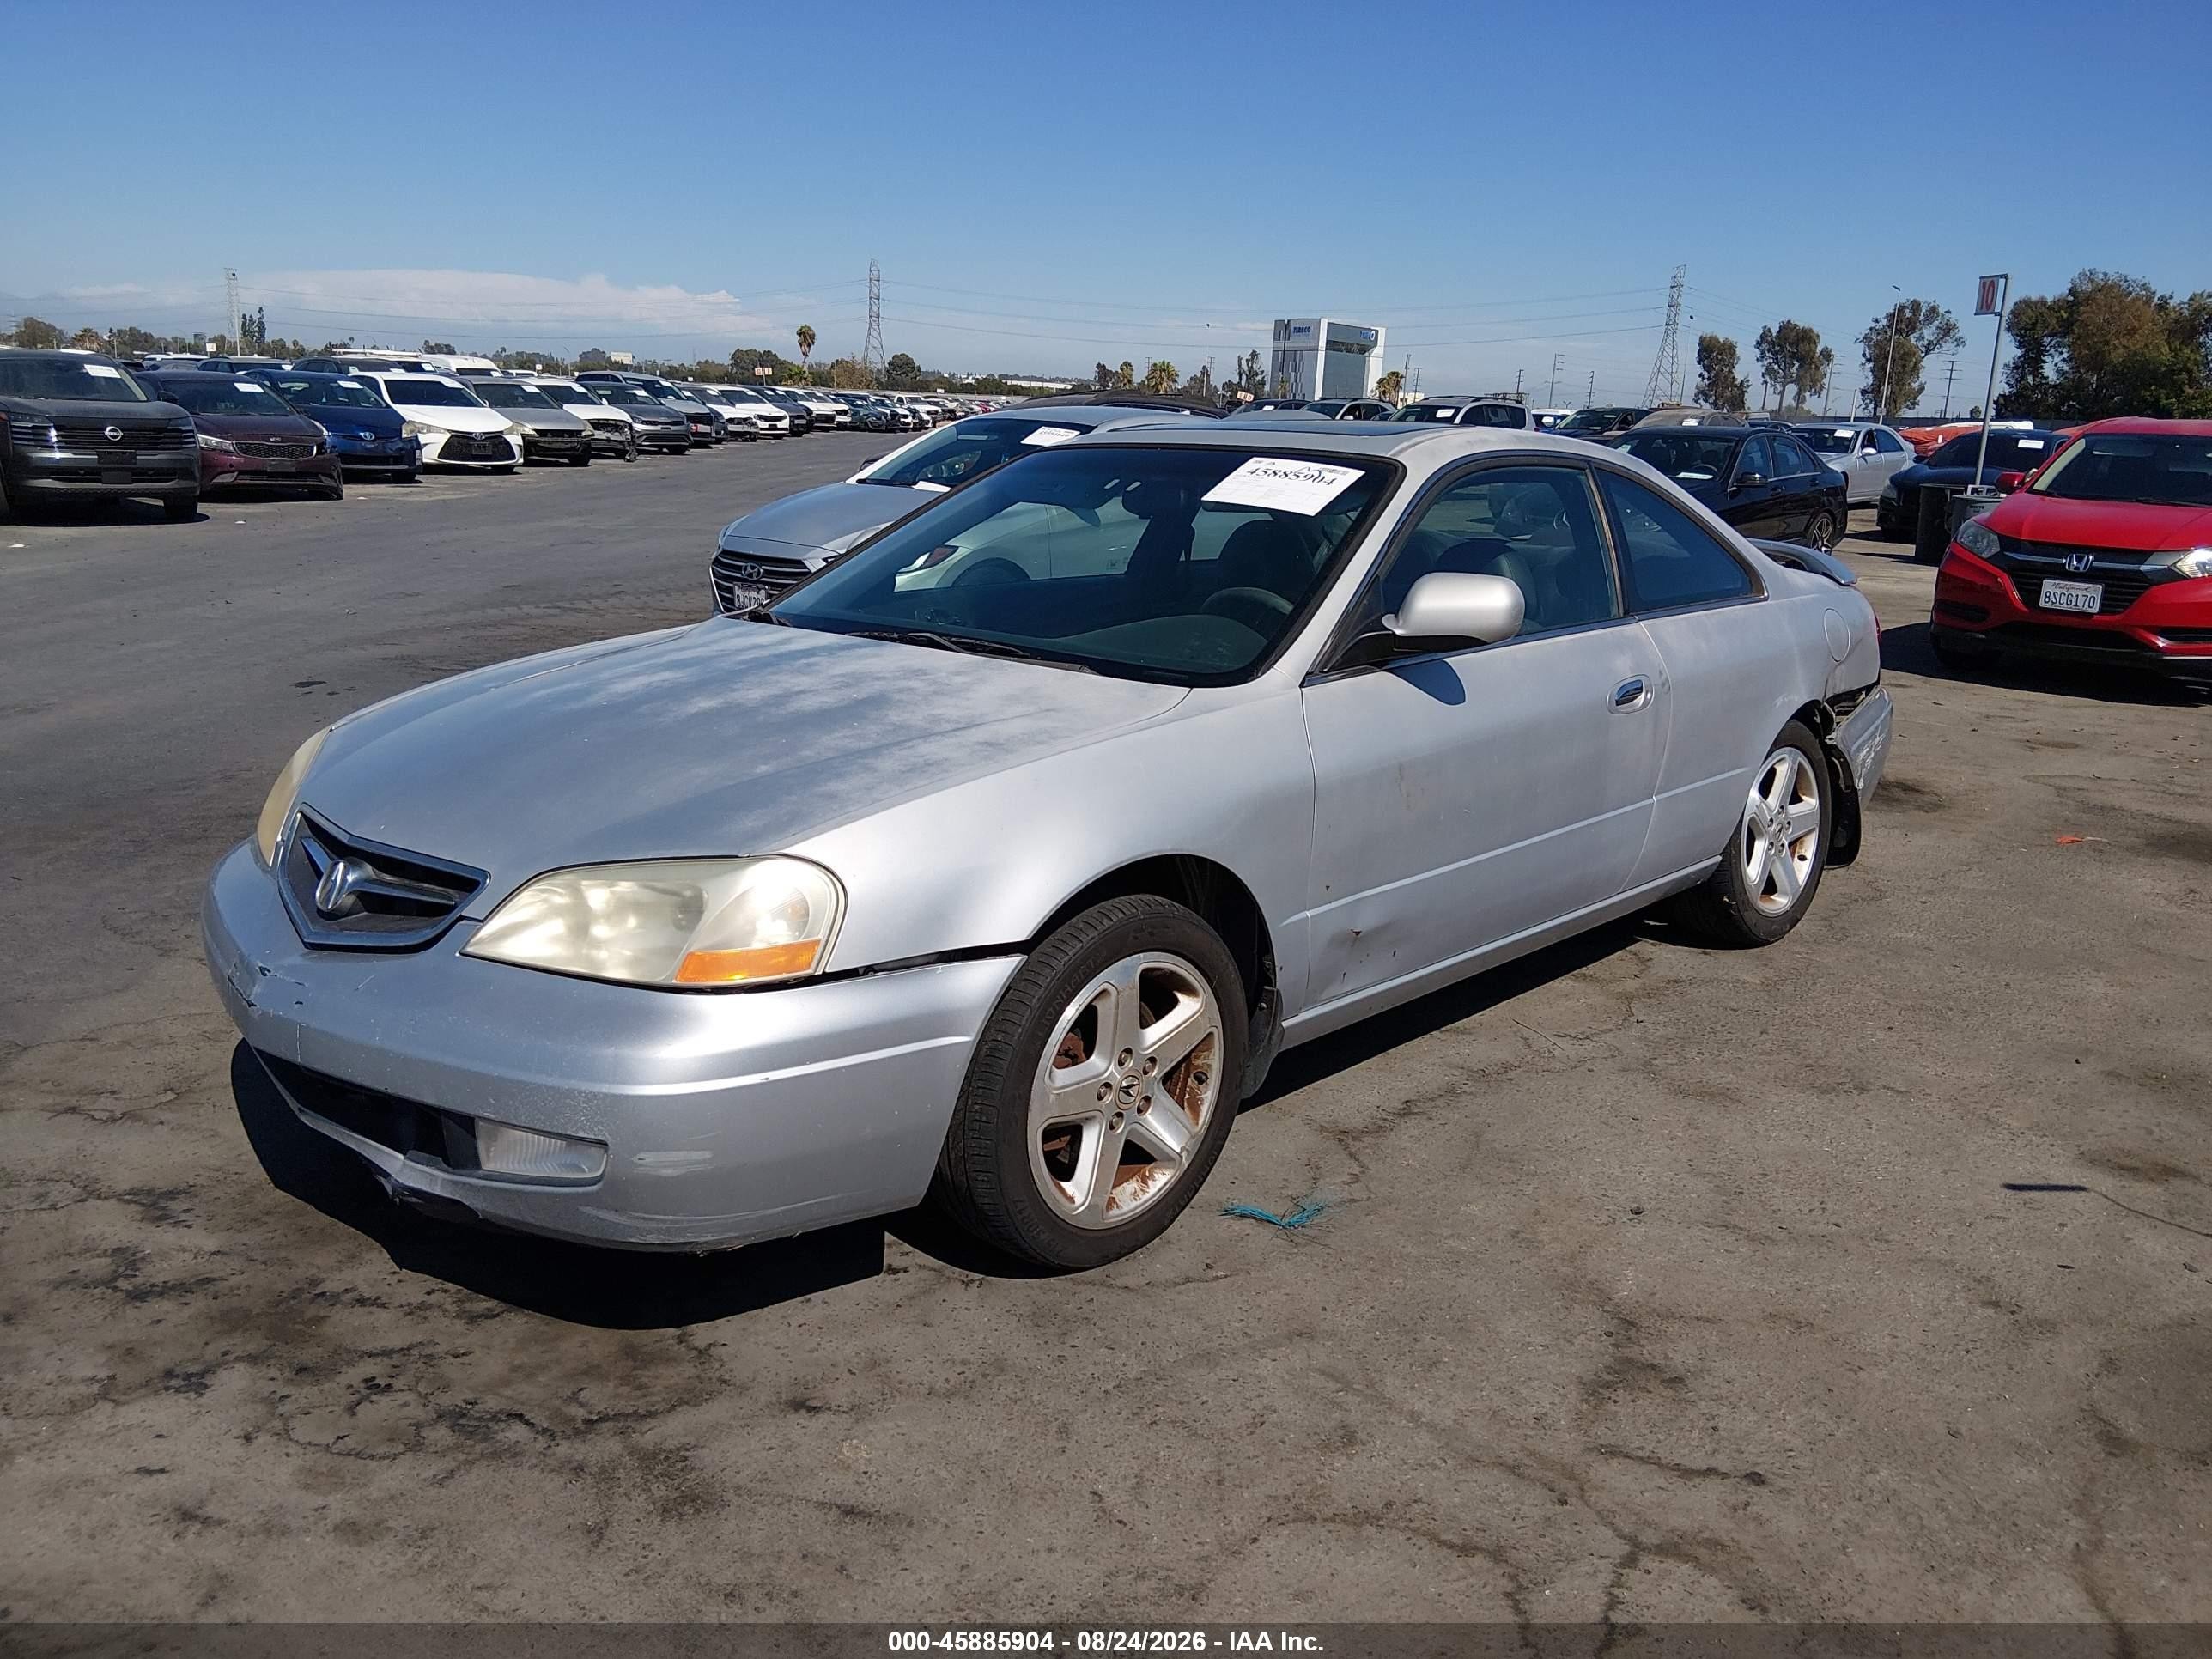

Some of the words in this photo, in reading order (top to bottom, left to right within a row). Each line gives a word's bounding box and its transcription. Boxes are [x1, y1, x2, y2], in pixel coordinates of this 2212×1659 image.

[1980, 280, 1995, 311] 10
[1247, 466, 1338, 486] 45885904
[2044, 590, 2096, 609] 8SCG170
